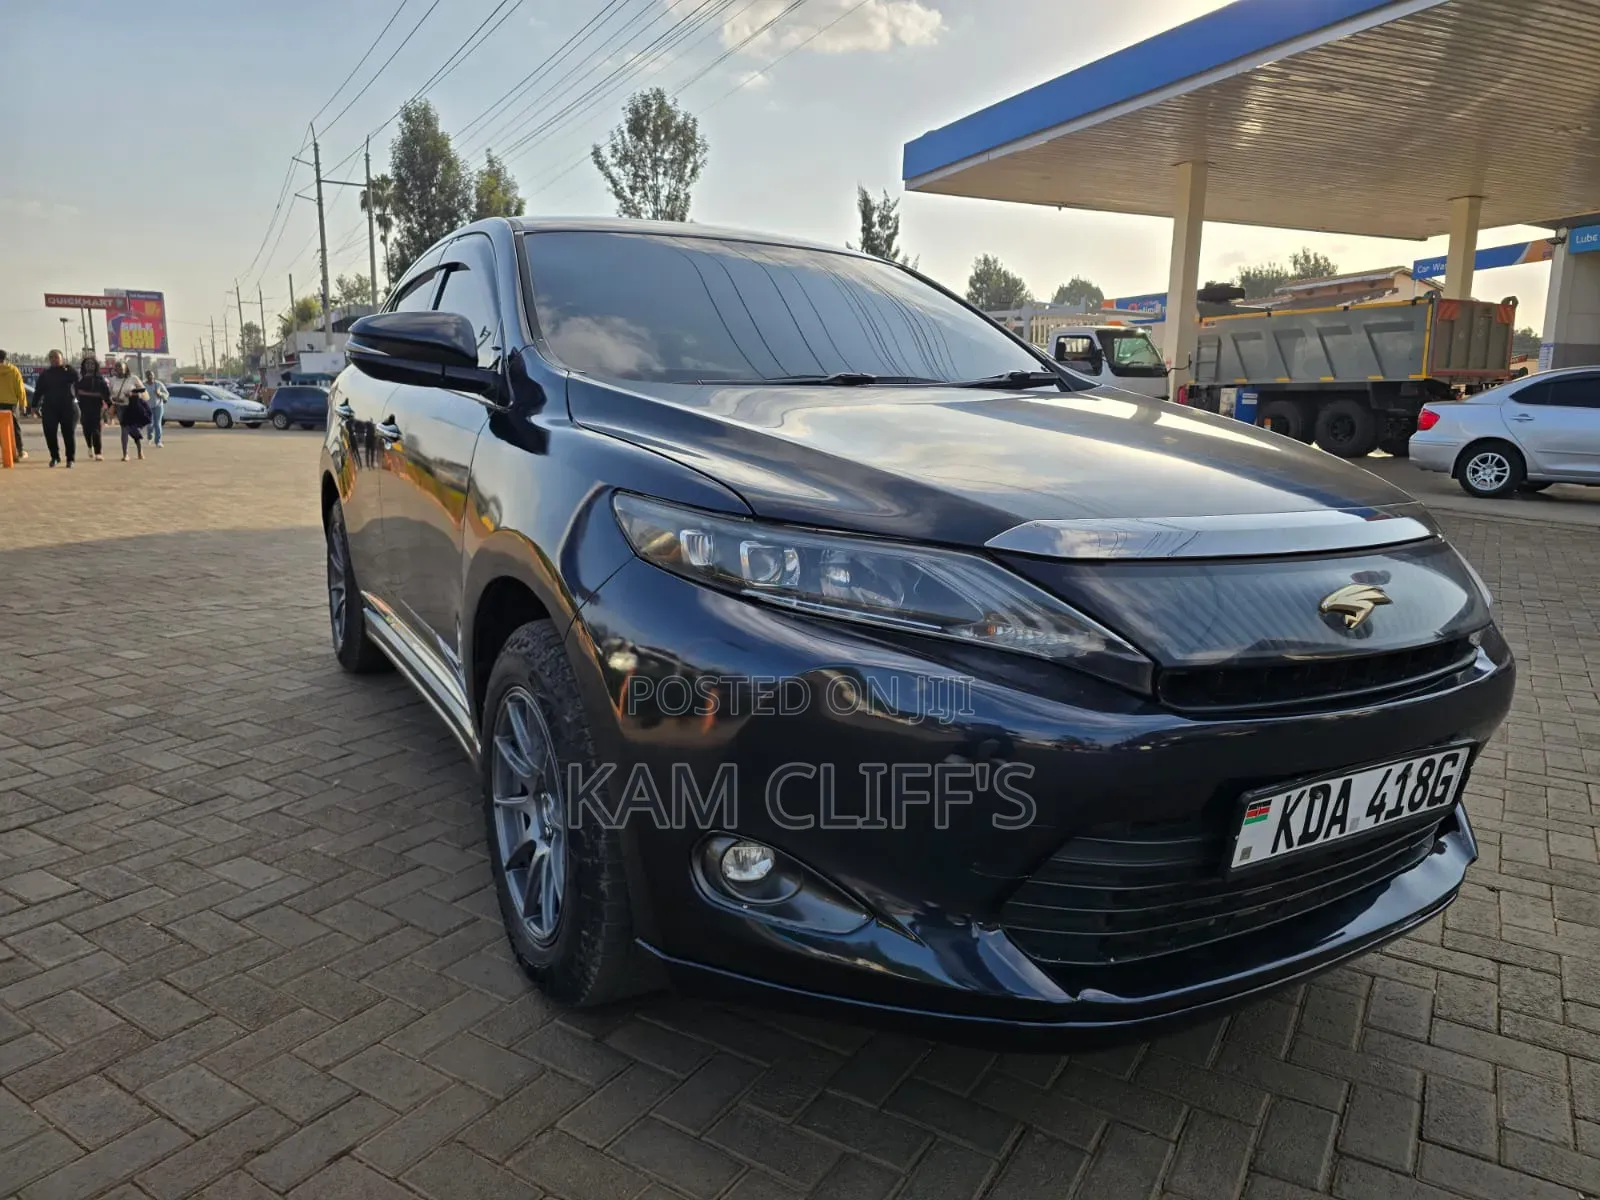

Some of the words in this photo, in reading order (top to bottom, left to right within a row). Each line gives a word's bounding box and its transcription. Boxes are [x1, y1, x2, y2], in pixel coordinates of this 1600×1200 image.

[1417, 264, 1430, 274] Car
[47, 296, 114, 308] QUICKMART
[1271, 778, 1352, 854] KDA
[1365, 752, 1461, 824] 418G
